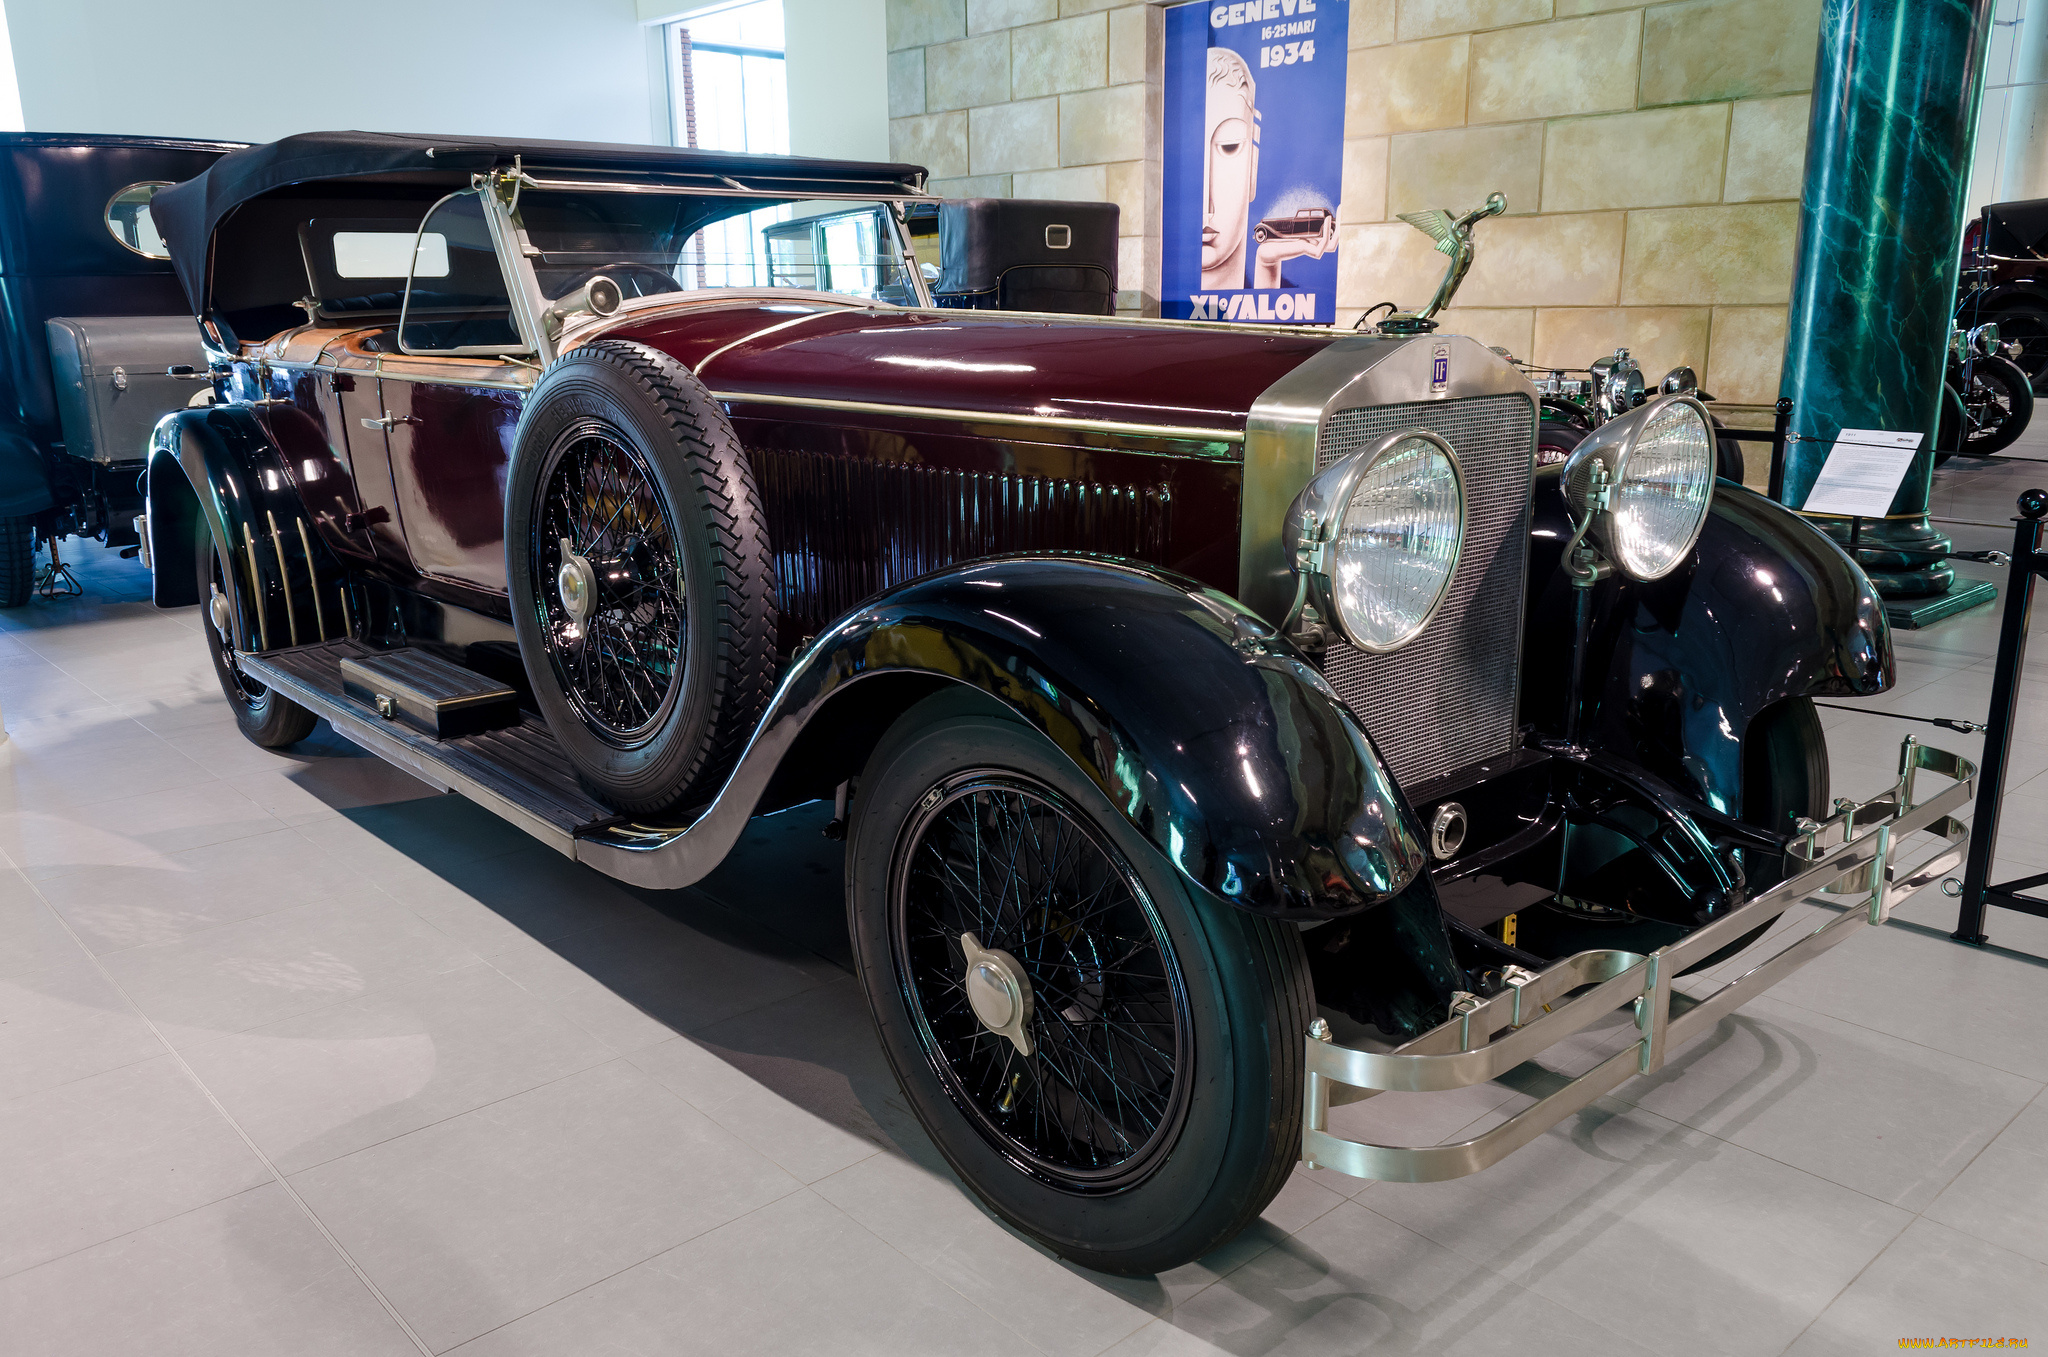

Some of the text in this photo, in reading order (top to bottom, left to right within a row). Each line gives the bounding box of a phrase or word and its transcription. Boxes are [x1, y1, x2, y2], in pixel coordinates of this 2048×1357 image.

[1261, 19, 1316, 41] 16-25 MARS
[1260, 40, 1315, 68] 1934
[1222, 293, 1315, 320] SALON
[1436, 361, 1446, 380] IF
